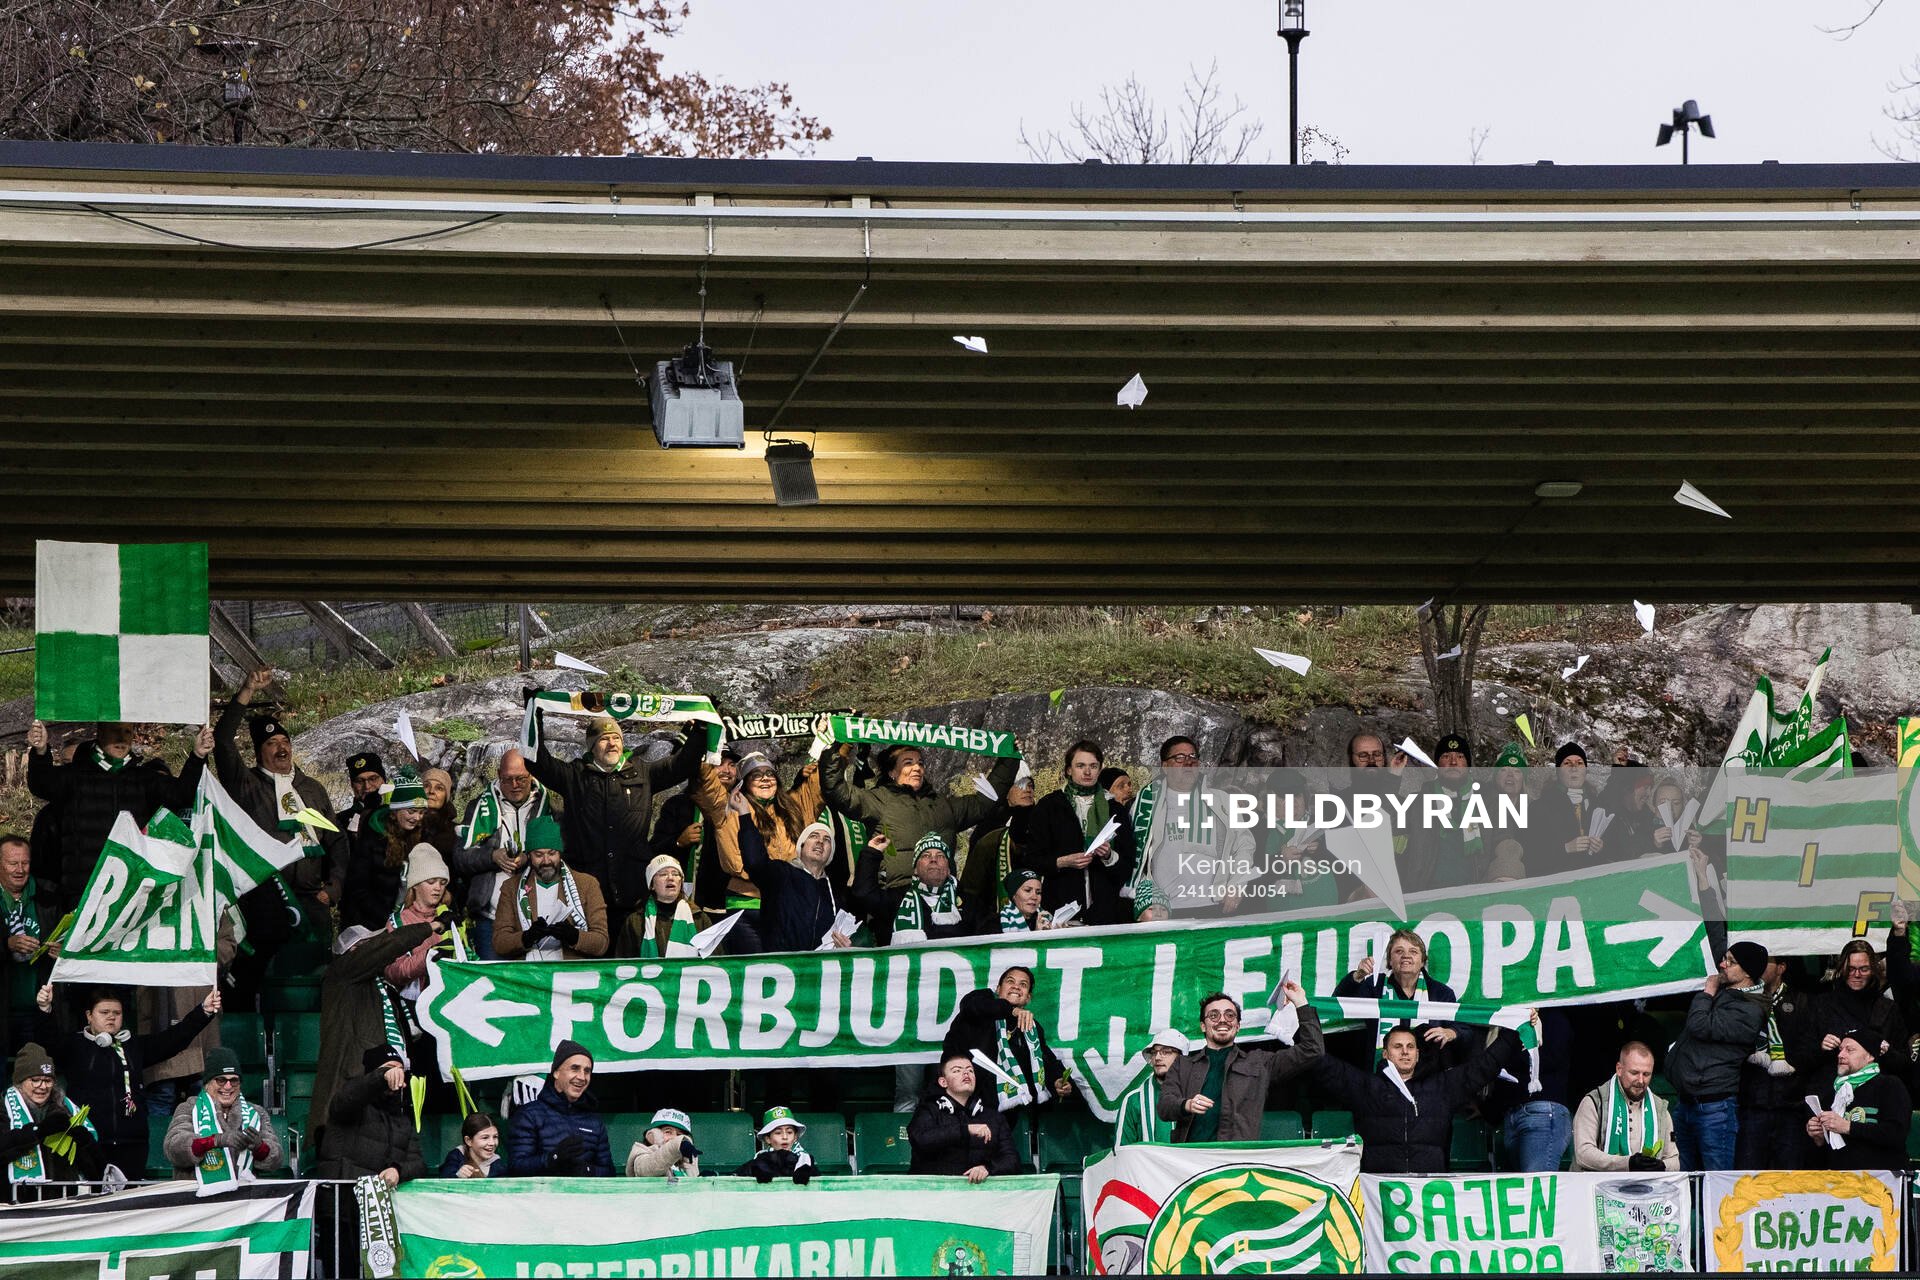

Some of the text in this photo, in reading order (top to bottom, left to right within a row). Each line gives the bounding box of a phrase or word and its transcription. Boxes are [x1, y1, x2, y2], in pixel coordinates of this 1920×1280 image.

[722, 715, 766, 739] Non
[765, 713, 810, 738] Plus
[845, 717, 1008, 754] HAMMARBY
[1378, 1174, 1558, 1242] BAJEN
[1754, 1205, 1874, 1251] BAJEN
